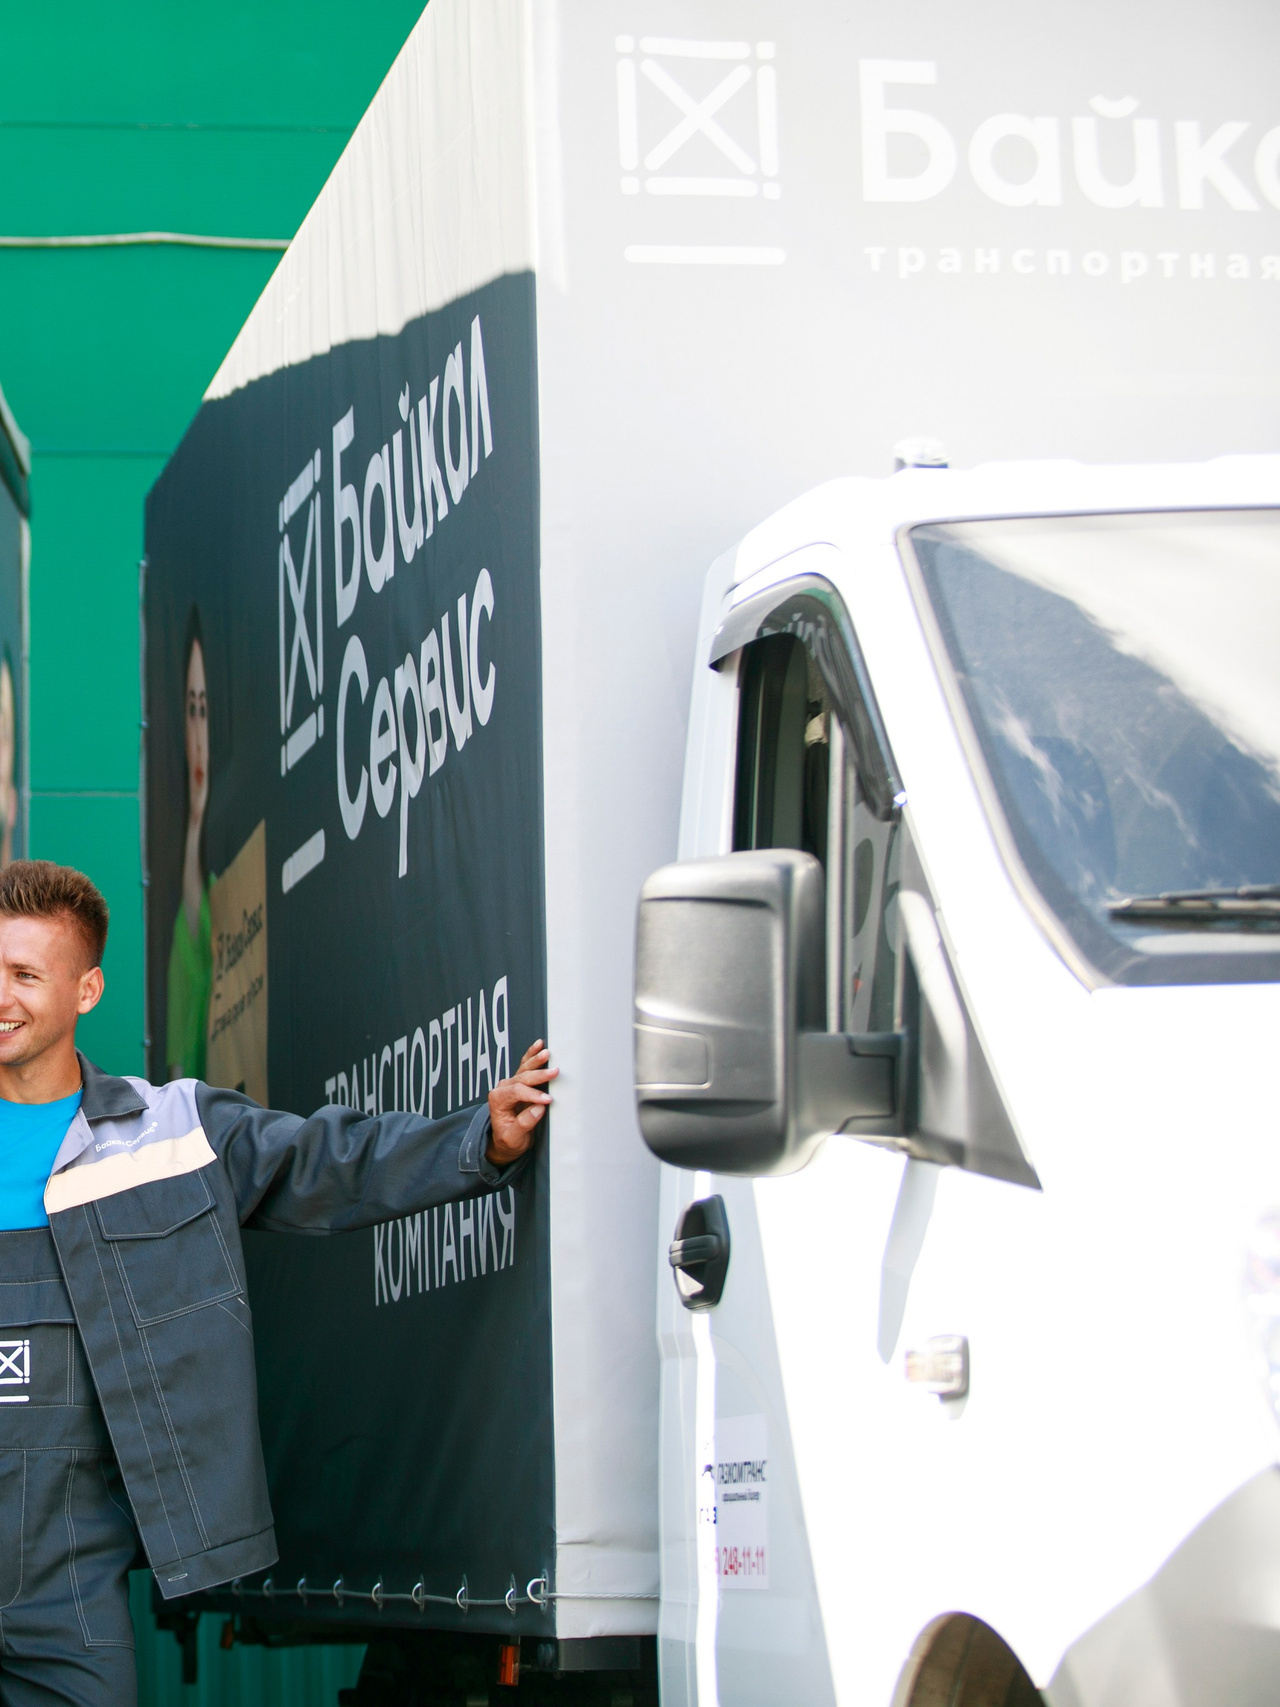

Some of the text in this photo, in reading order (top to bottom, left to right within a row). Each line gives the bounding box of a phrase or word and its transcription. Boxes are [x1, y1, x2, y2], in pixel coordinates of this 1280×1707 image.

[861, 60, 1280, 211] Байк
[863, 244, 1280, 284] транспортная
[332, 314, 494, 629] Байкал
[336, 567, 497, 879] Сервис
